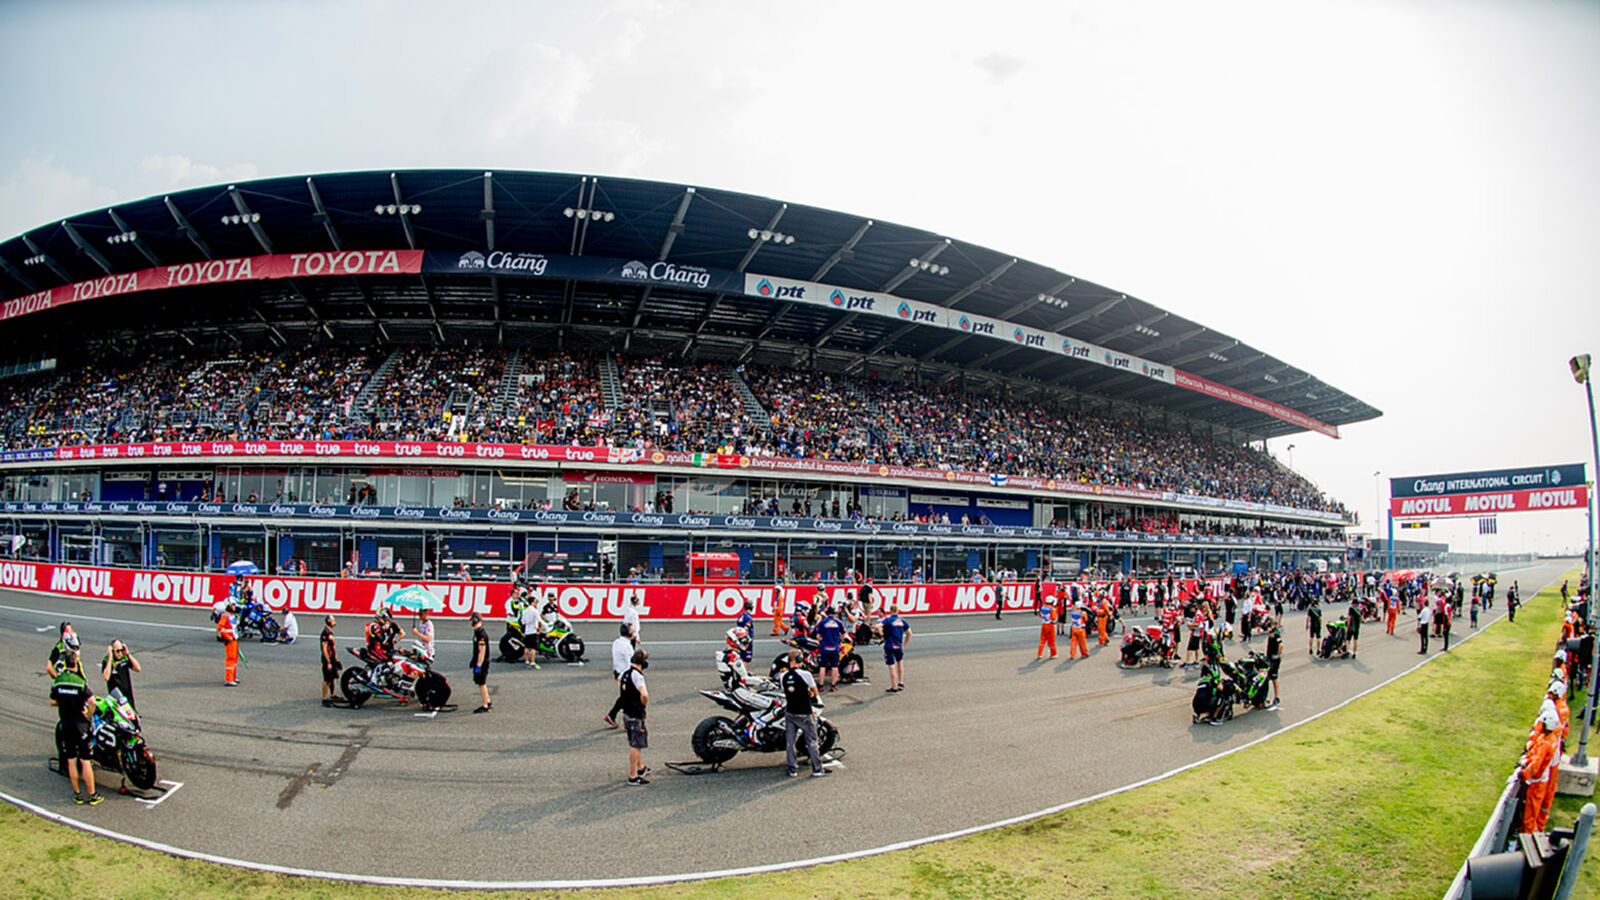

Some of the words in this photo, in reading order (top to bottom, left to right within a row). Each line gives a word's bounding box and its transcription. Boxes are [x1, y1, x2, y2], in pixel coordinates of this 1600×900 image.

[290, 250, 400, 275] TOYOTA
[486, 250, 548, 275] Chang
[166, 258, 252, 286] TOYOTA
[649, 262, 711, 288] Chang
[72, 272, 138, 301] TOYOTA
[774, 285, 806, 301] ptt
[3, 290, 52, 318] TOYOTA
[846, 296, 876, 312] ptt
[912, 308, 938, 324] ptt
[971, 321, 996, 336] ptt
[1024, 333, 1047, 348] ptt
[1071, 345, 1091, 359] ptt
[1111, 356, 1130, 370] ptt
[1147, 365, 1165, 379] ptt
[1176, 374, 1203, 390] HONDA
[127, 446, 144, 456] true
[153, 444, 172, 455] true
[181, 444, 202, 454] true
[212, 443, 234, 454] true
[245, 443, 267, 454] true
[280, 443, 304, 454] true
[315, 443, 340, 454] true
[354, 443, 380, 454] true
[395, 443, 422, 455] true
[437, 445, 465, 456] true
[476, 445, 504, 457] true
[521, 446, 549, 458] true
[565, 448, 594, 460] true
[1414, 479, 1446, 493] Chang
[1447, 476, 1509, 491] INTERNATIONAL
[1512, 473, 1543, 485] CIRCUIT
[781, 482, 819, 498] Chang
[1464, 494, 1515, 511] MOTUL
[1528, 490, 1577, 508] MOTUL
[84, 503, 102, 512] Chang
[109, 503, 129, 513] Chang
[137, 503, 157, 513] Chang
[167, 503, 188, 513] Chang
[198, 503, 221, 513] Chang
[232, 503, 257, 514] Chang
[269, 504, 295, 515] Chang
[309, 505, 336, 516] Chang
[350, 505, 380, 517] Chang
[394, 506, 425, 518] Chang
[1401, 498, 1452, 514] MOTUL
[439, 508, 471, 519] Chang
[487, 509, 519, 520] Chang
[535, 510, 567, 522] Chang
[583, 511, 615, 523] Chang
[632, 513, 664, 524] Chang
[678, 514, 710, 526] Chang
[725, 515, 755, 527] Chang
[770, 516, 798, 528] Chang
[813, 518, 841, 530] Chang
[854, 520, 881, 532] Chang
[893, 521, 918, 533] Chang
[928, 522, 952, 534] Chang
[962, 524, 985, 535] Chang
[994, 525, 1015, 536] Chang
[0, 562, 38, 589] OTUL
[50, 567, 113, 596] MOTUL
[131, 573, 215, 604] MOTUL
